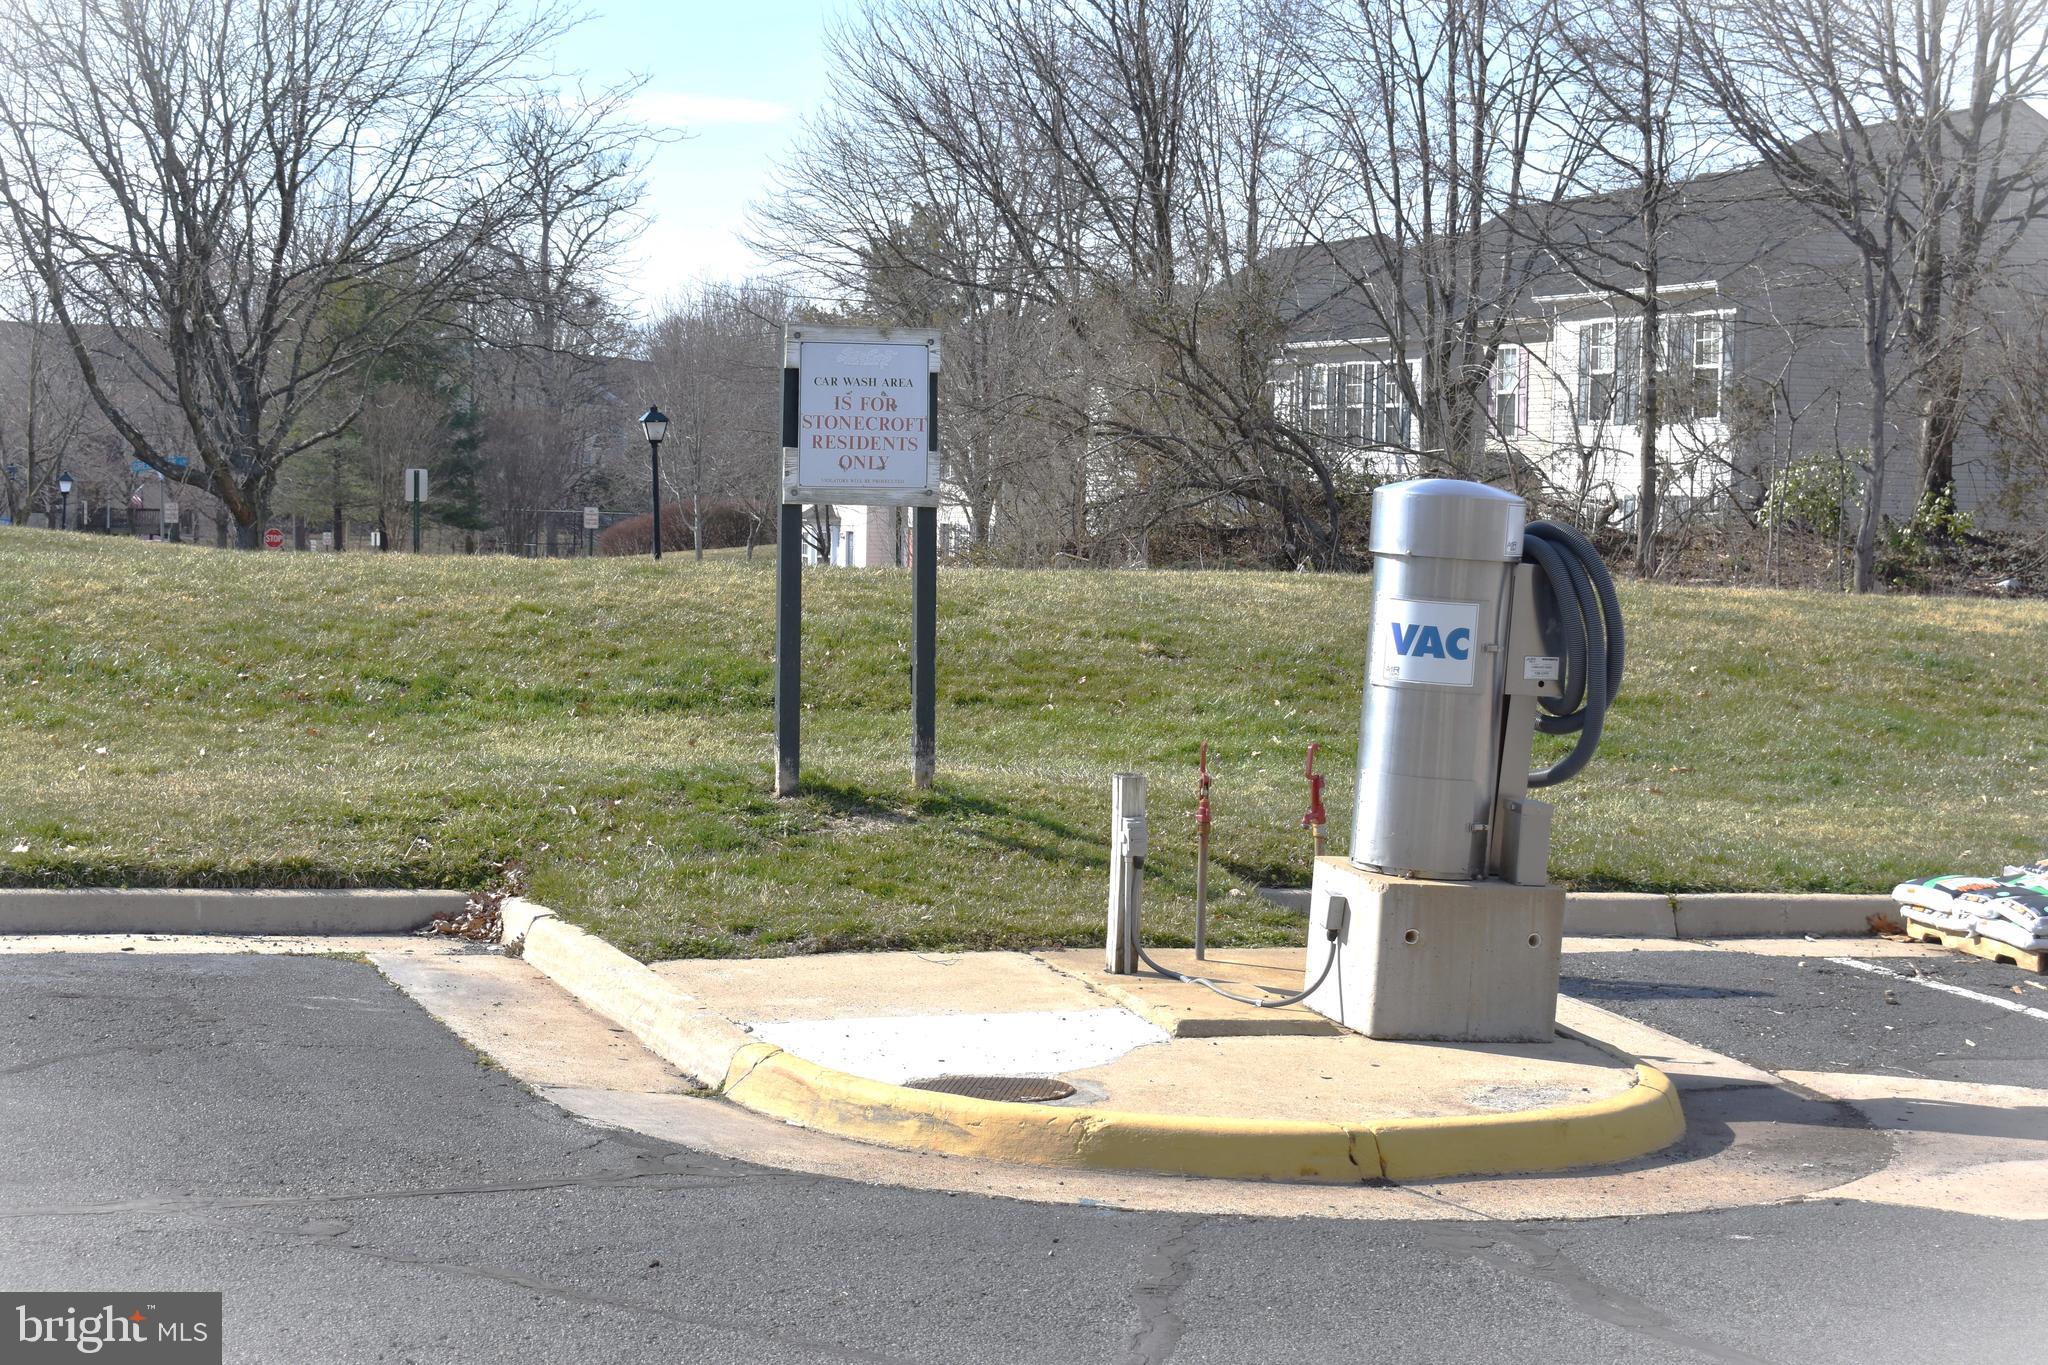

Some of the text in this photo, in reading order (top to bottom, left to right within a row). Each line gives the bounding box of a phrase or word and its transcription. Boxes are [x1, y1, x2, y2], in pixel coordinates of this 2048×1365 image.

[813, 376, 914, 388] CAR WASH AREA
[834, 396, 898, 412] IS FOR
[802, 414, 927, 433] STONECROFT
[812, 434, 918, 452] RESIDENTS
[839, 455, 890, 471] ONLY
[265, 534, 284, 543] STOP
[1391, 622, 1470, 661] VAC
